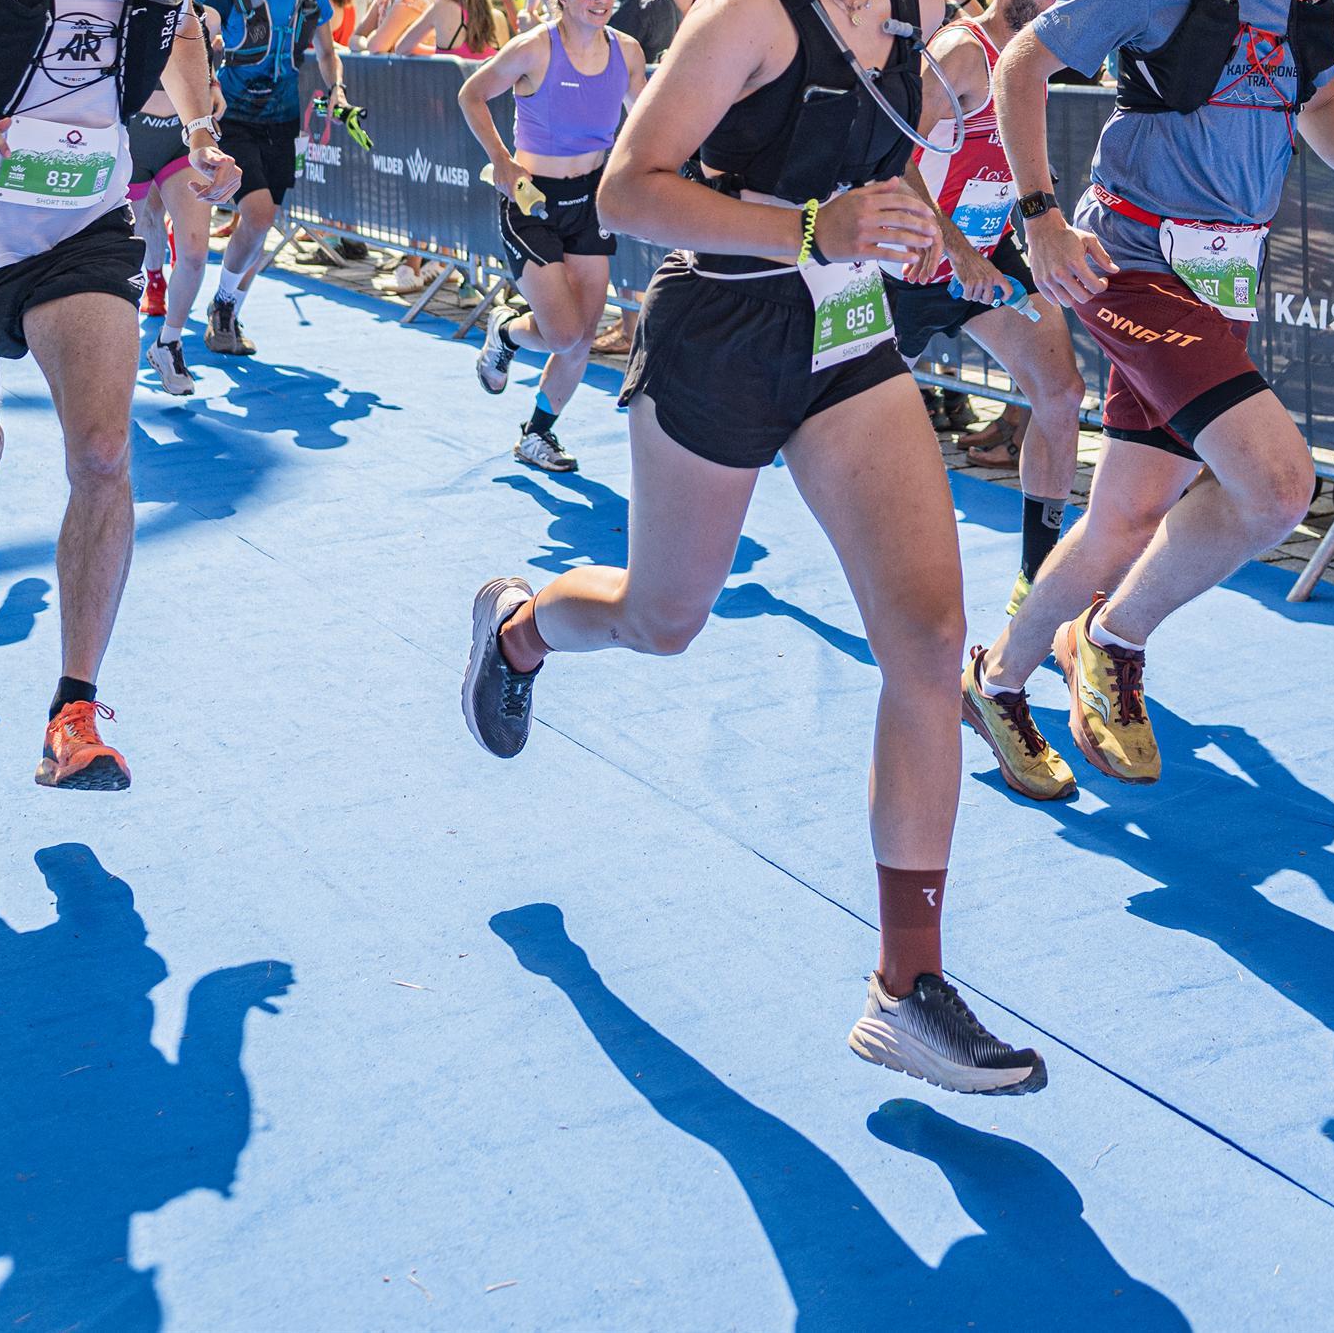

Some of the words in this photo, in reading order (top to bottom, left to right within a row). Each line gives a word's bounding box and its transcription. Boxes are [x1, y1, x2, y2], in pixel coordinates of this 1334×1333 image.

[162, 9, 177, 39] Rab
[142, 115, 179, 128] NIKE
[46, 170, 84, 188] 837
[305, 162, 326, 184] TRAIL
[372, 154, 404, 176] WILDER
[434, 164, 470, 187] KAISER
[36, 197, 60, 206] SHORT
[981, 216, 1002, 230] 255
[846, 302, 875, 330] 856
[842, 344, 861, 357] SHORT
